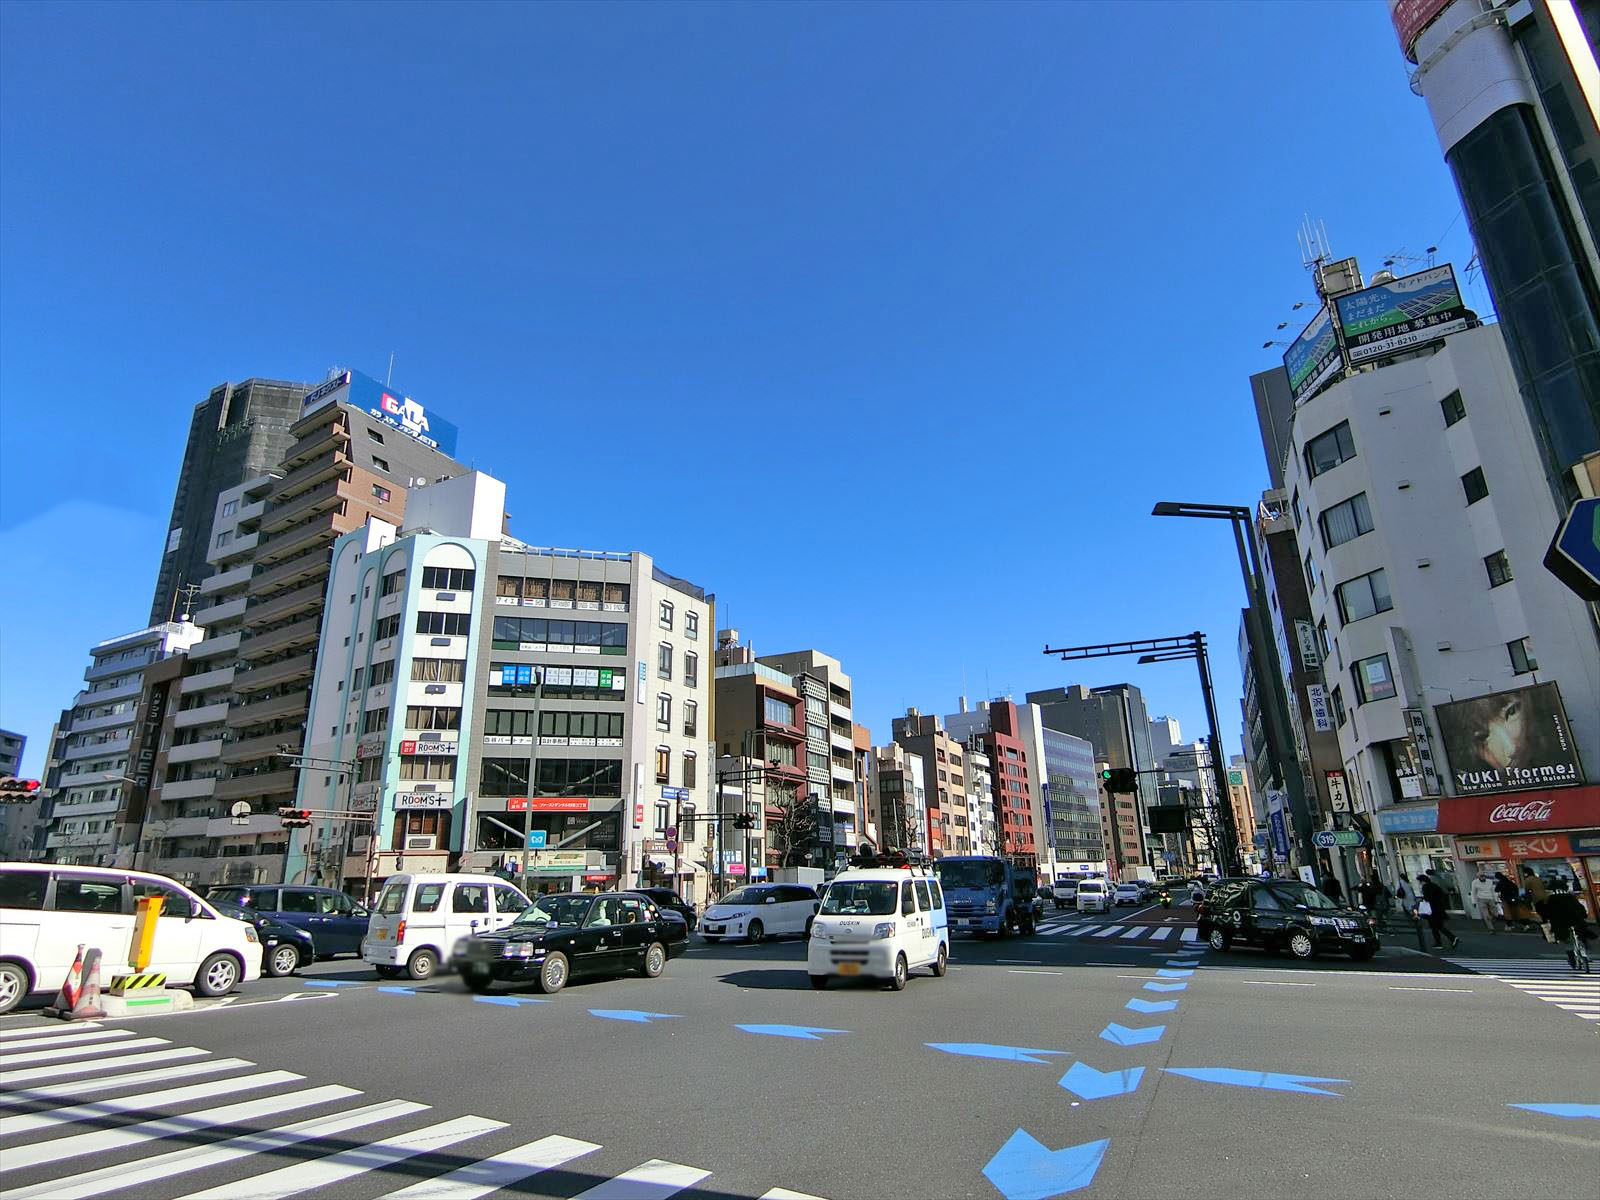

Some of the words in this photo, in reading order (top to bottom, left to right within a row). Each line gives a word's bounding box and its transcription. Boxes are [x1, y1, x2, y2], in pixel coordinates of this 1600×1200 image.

[1358, 324, 1410, 344] 開発用地
[1414, 311, 1453, 329] 募集中
[1311, 688, 1329, 728] 北沢歯科
[1413, 716, 1435, 777] 鈴木眼科
[1457, 769, 1500, 785] YUKI
[1543, 773, 1576, 782] Release
[1331, 778, 1345, 811] 牛カツ
[1320, 835, 1335, 844] 319
